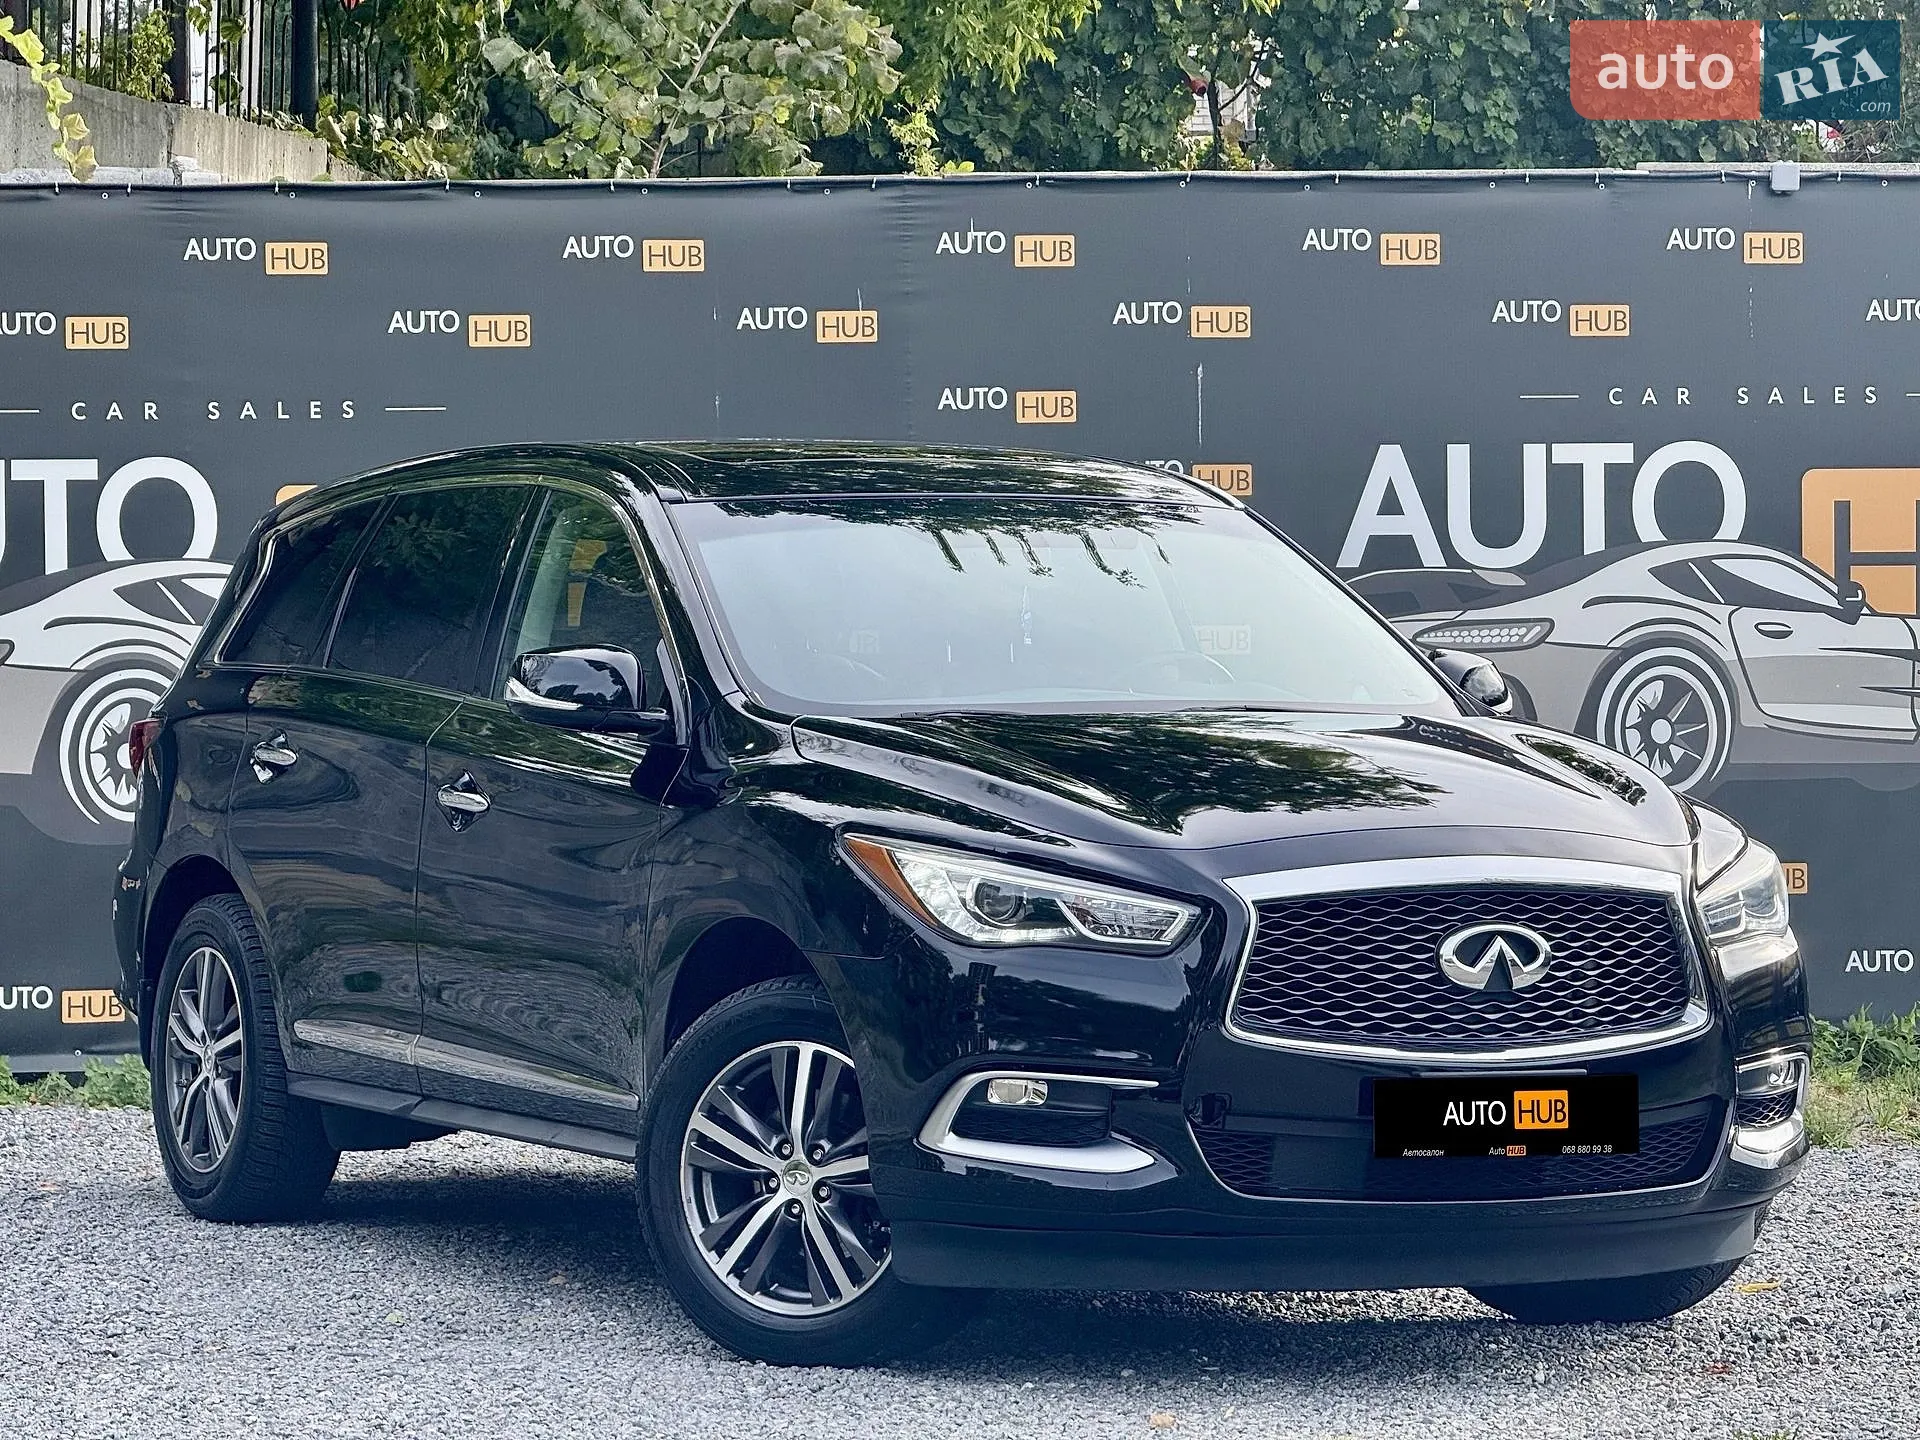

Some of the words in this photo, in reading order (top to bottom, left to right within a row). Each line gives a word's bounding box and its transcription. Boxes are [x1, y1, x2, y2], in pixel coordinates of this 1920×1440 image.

[184, 237, 257, 261] AUTO
[270, 247, 326, 270] HUB
[562, 235, 635, 259] AUTO
[648, 245, 702, 267] HUB
[936, 232, 1006, 255] AUTO
[1020, 240, 1073, 263] HUB
[1302, 228, 1372, 251] AUTO
[1385, 238, 1438, 261] HUB
[1666, 227, 1736, 250] AUTO
[1749, 237, 1801, 260] HUB
[387, 309, 460, 334] AUTO
[474, 320, 528, 343] HUB
[736, 306, 808, 330] AUTO
[821, 315, 875, 338] HUB
[1112, 300, 1183, 325] AUTO
[1196, 311, 1249, 334] HUB
[1491, 299, 1562, 323] AUTO
[1575, 309, 1628, 332] HUB
[71, 322, 127, 345] HUB
[71, 402, 159, 420] CAR
[207, 400, 354, 420] SALES
[938, 386, 1008, 410] AUTO
[1021, 396, 1074, 419] HUB
[1608, 387, 1691, 405] CAR
[1737, 386, 1877, 405] SALES
[1197, 469, 1250, 491] HUB
[0, 457, 217, 575] TO
[1336, 440, 1747, 569] AUTO
[1845, 949, 1914, 972] AUTO
[67, 995, 123, 1018] HUB
[1443, 1100, 1507, 1126] AUTO
[1518, 1099, 1567, 1125] HUB
[1488, 1146, 1506, 1156] Auto
[1507, 1146, 1525, 1155] HUB
[1592, 1144, 1602, 1154] 99
[1603, 1144, 1613, 1154] 38
